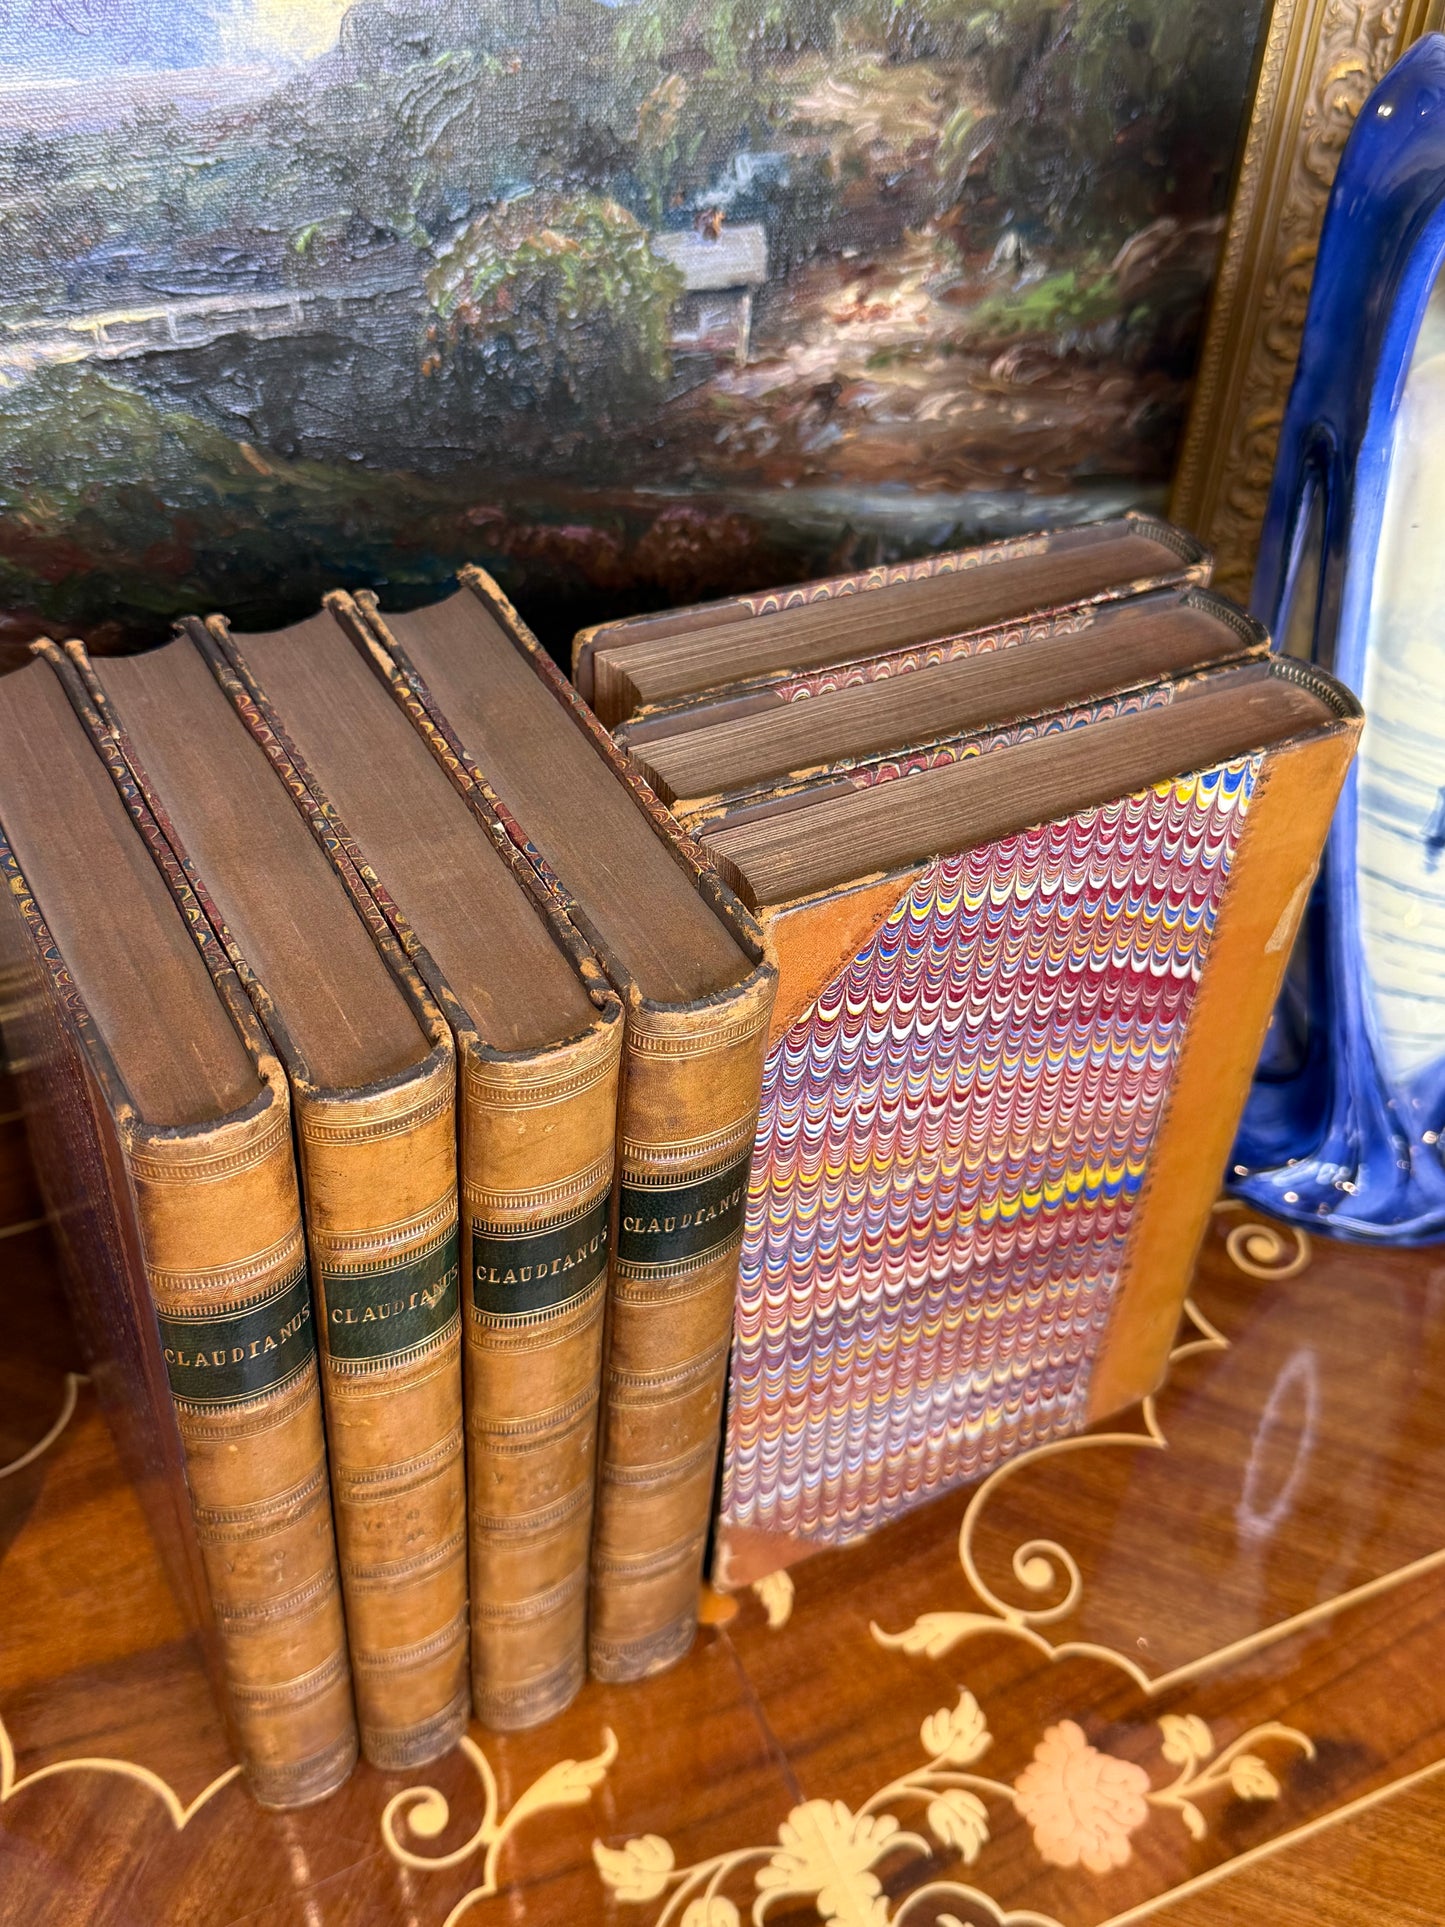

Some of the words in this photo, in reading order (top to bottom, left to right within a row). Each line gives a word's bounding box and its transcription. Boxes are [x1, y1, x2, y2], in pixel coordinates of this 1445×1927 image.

[476, 1225, 608, 1284] CLAUDIANUS
[331, 1263, 458, 1323] CLAUDIANUS
[164, 1302, 311, 1367] CLAUDIANUS
